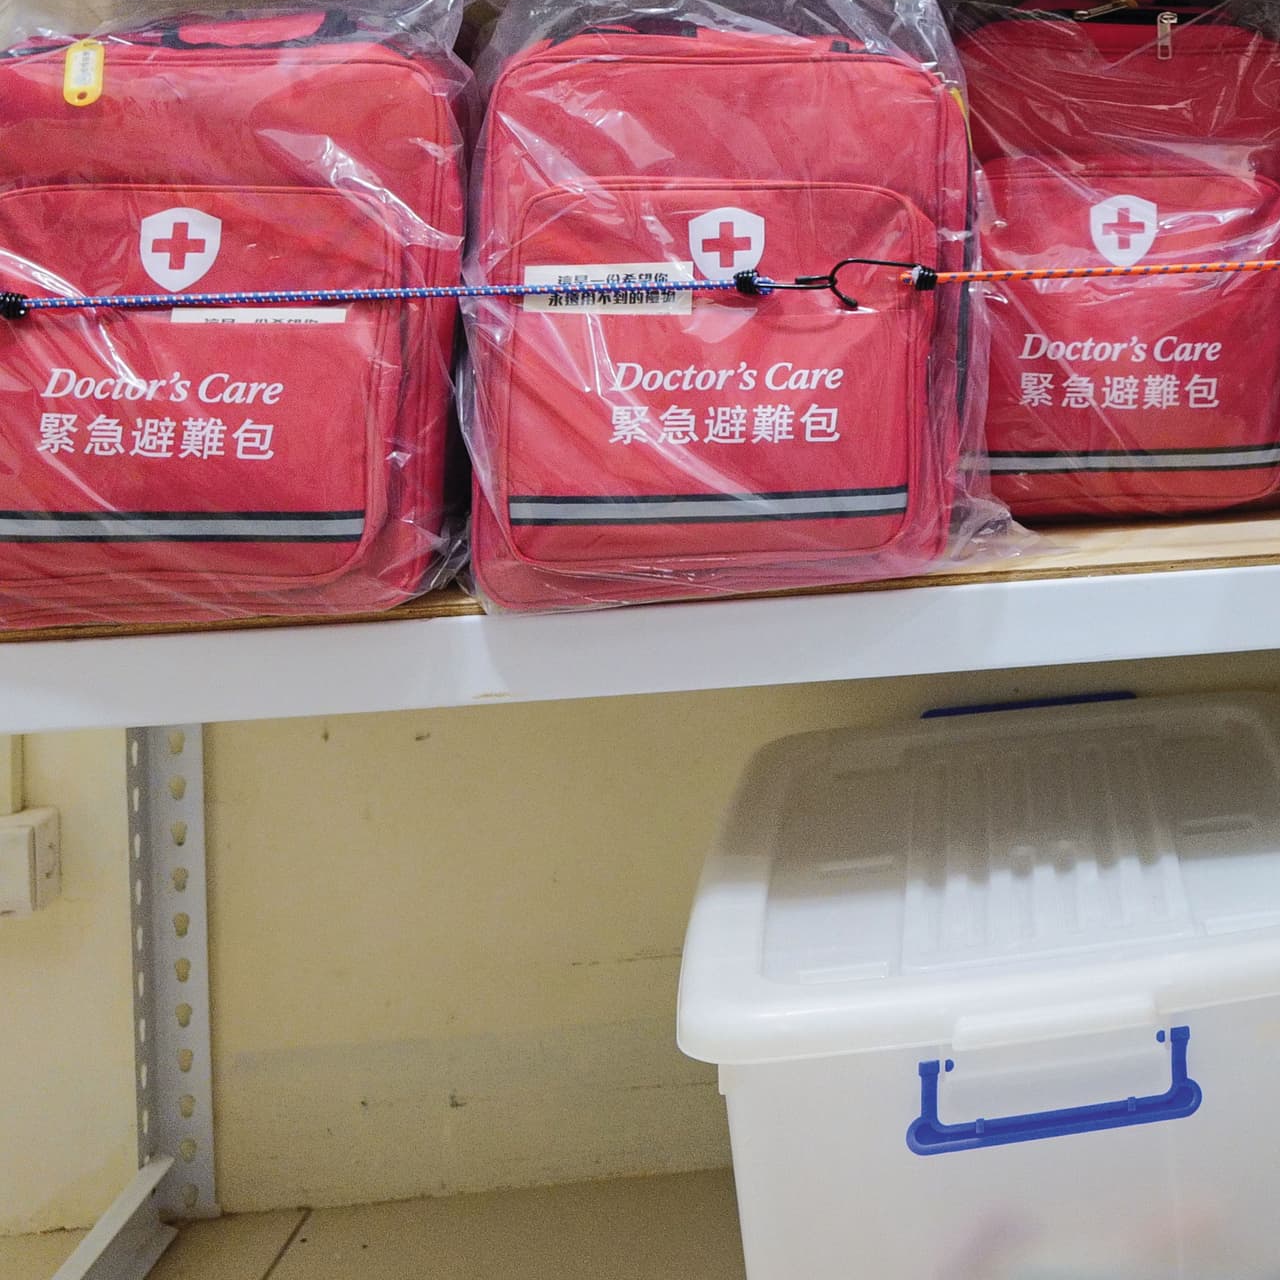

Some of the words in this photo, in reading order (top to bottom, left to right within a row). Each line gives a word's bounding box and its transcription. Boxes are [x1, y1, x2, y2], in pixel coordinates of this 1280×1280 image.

[1018, 333, 1146, 362] Doctor's
[1153, 335, 1222, 362] Care
[41, 368, 190, 403] Doctor's
[199, 374, 284, 405] Care
[611, 361, 758, 392] Doctor's
[767, 363, 844, 391] Care
[1019, 372, 1220, 410] 緊急避難包
[37, 412, 275, 461] 緊急避難包
[608, 403, 841, 445] 緊急避難包
